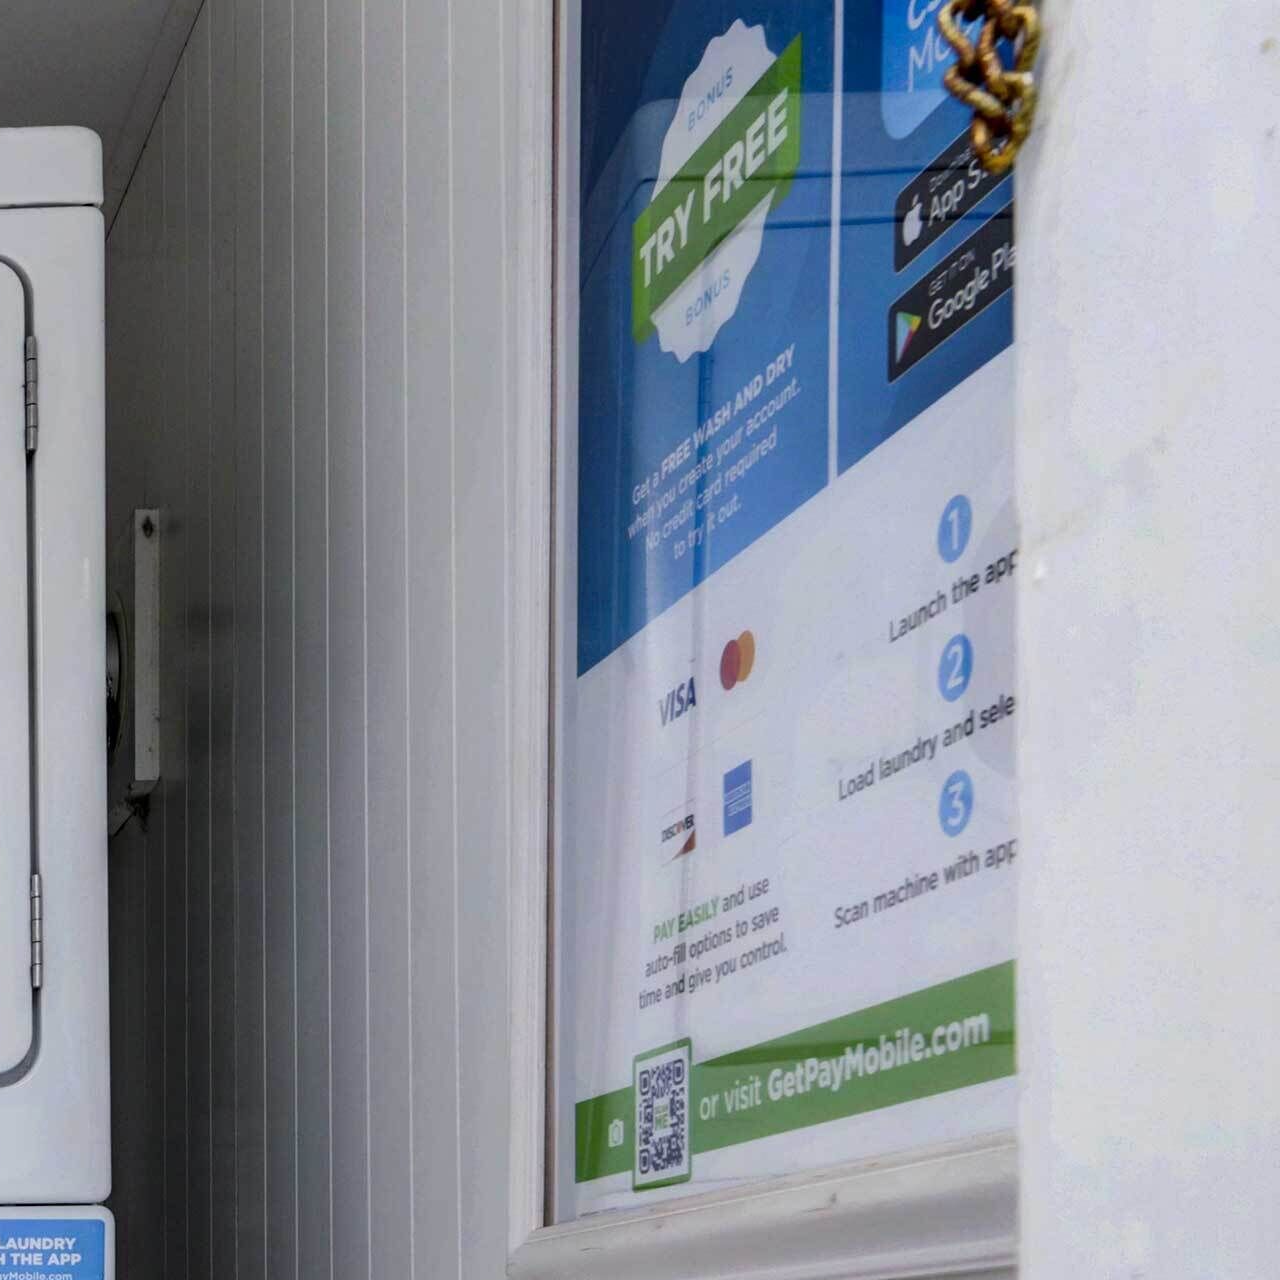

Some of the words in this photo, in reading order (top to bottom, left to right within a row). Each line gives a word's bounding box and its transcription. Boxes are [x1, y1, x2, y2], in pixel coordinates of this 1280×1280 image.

[687, 66, 734, 132] BONUS
[639, 188, 695, 288] TRY
[703, 87, 788, 223] FREE
[927, 180, 964, 229] App
[685, 268, 730, 326] BONUS
[927, 266, 989, 329] Google
[991, 242, 1014, 280] Pla
[631, 477, 650, 505] Get
[661, 437, 691, 479] FREE
[692, 401, 730, 449] WASH
[732, 373, 763, 416] AND
[765, 343, 794, 386] DRY
[888, 590, 947, 643] Launch
[951, 573, 980, 603] the
[660, 676, 696, 725] VISA
[947, 643, 965, 690] 2
[839, 762, 874, 800] Load
[879, 734, 937, 779] laundry
[942, 709, 974, 747] and
[979, 694, 1014, 729] sele
[947, 781, 966, 827] 3
[834, 900, 868, 928] Scan
[873, 871, 938, 913] machine
[943, 850, 980, 884] with
[699, 1093, 719, 1120] or
[723, 1075, 761, 1113] visit
[767, 1012, 989, 1101] GetPayMobile.com
[9, 1252, 43, 1266] THE
[47, 1253, 82, 1266] APP
